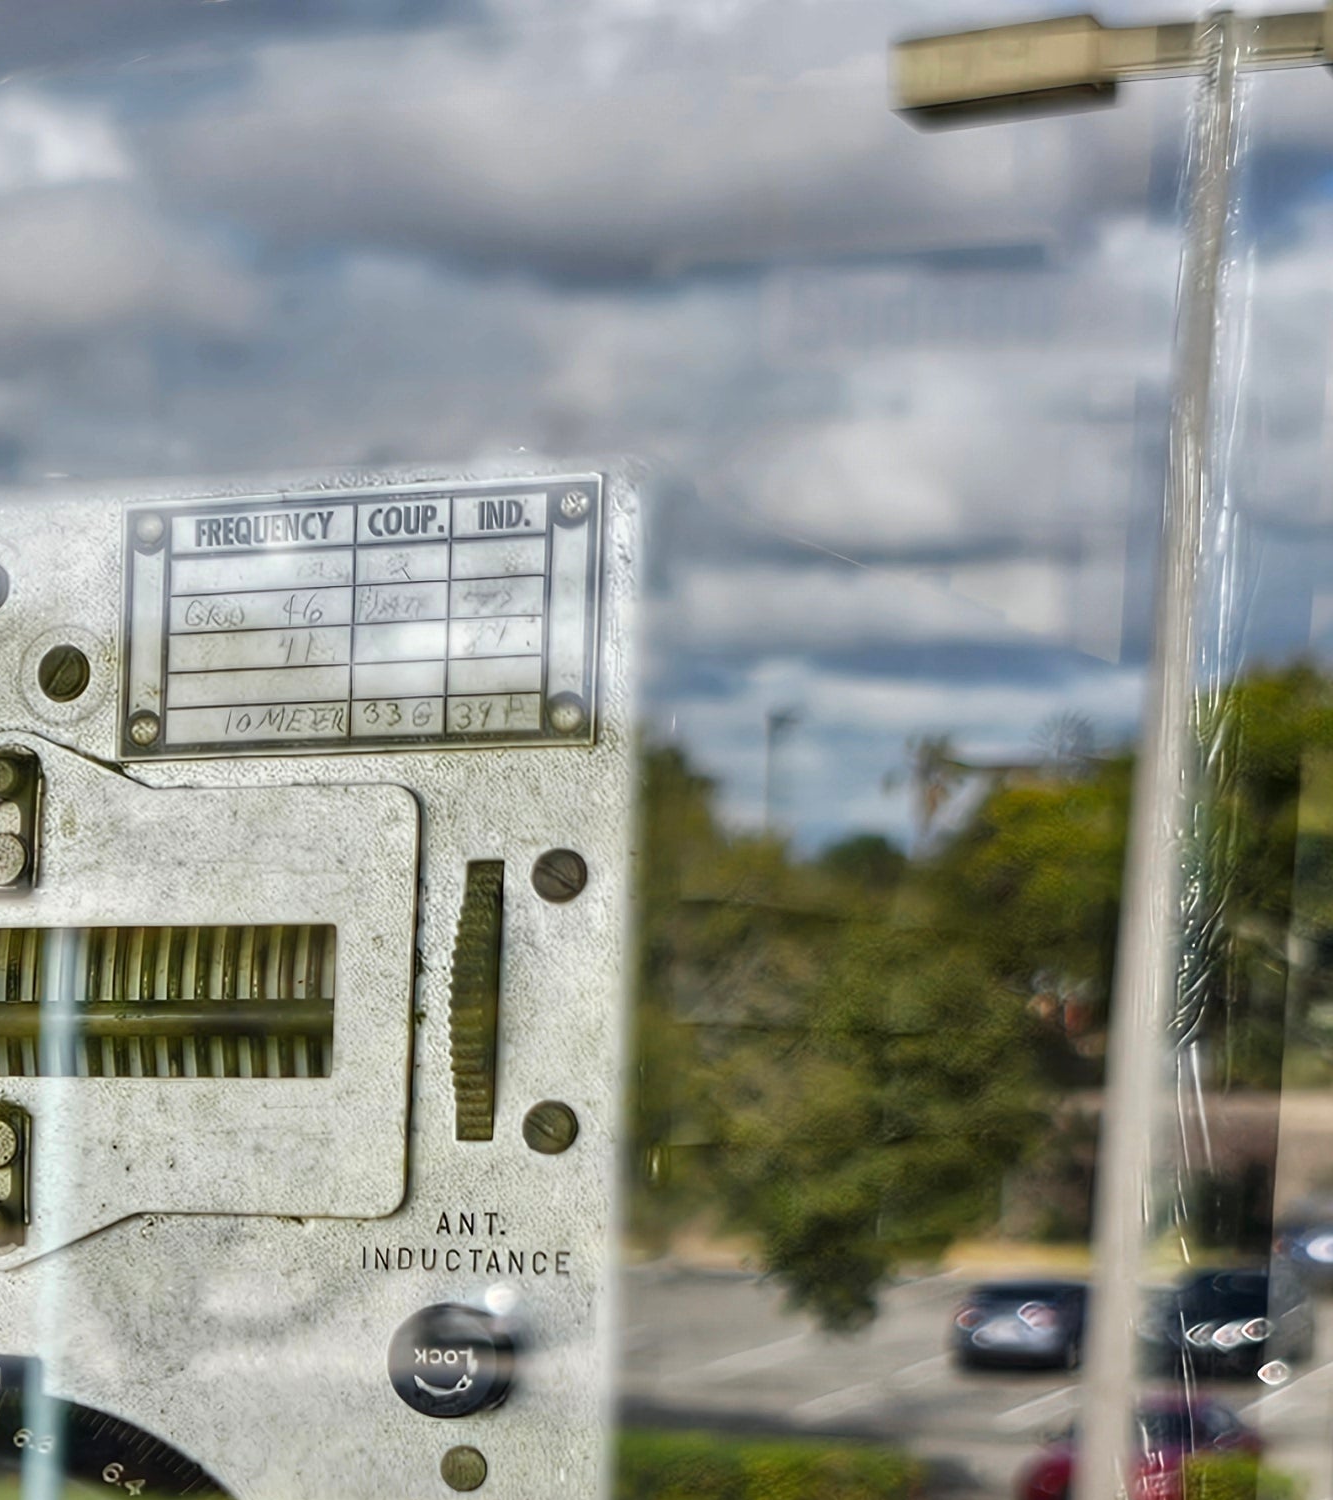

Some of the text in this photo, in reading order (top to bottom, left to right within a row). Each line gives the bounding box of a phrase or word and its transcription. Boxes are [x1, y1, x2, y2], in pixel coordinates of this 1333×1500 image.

[195, 501, 531, 547] FREQUENCY COUP. IND.
[435, 1211, 506, 1236] ANT.
[361, 1246, 572, 1276] INDUCTANCE
[413, 1347, 476, 1366] LOCK
[101, 1461, 146, 1496] 6.4
